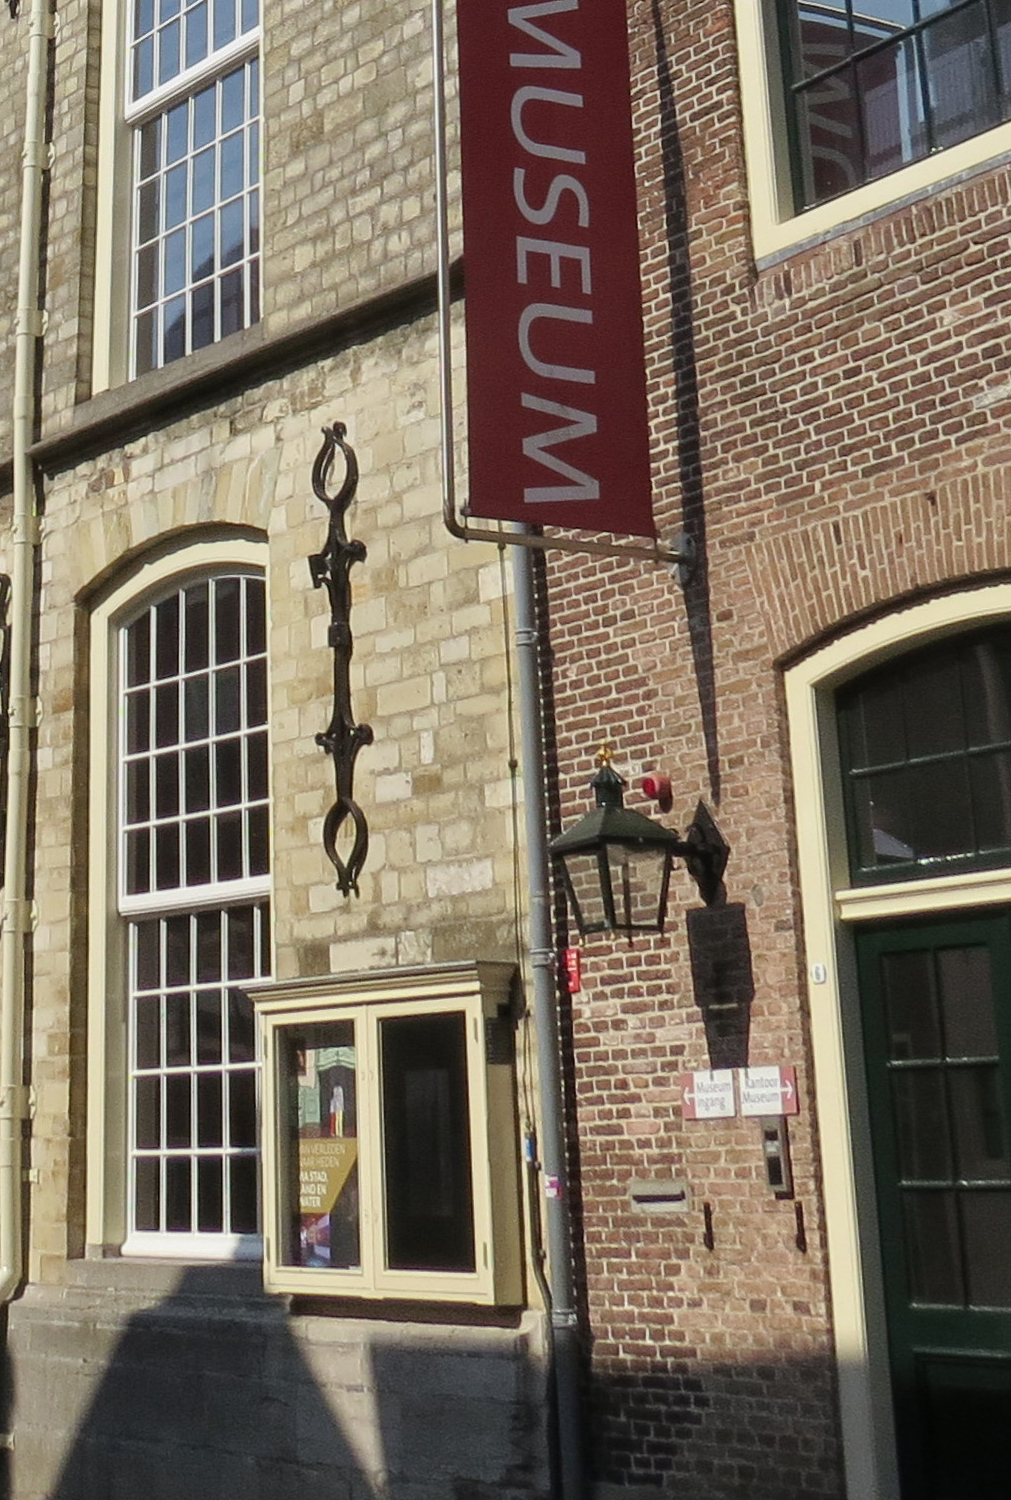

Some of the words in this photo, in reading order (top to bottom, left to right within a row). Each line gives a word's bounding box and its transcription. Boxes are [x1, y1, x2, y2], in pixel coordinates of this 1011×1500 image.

[696, 1081, 731, 1093] Museum
[745, 1076, 779, 1089] Kantoor
[742, 1092, 779, 1104] Museum
[299, 1183, 316, 1195] AND
[317, 1183, 327, 1196] EN
